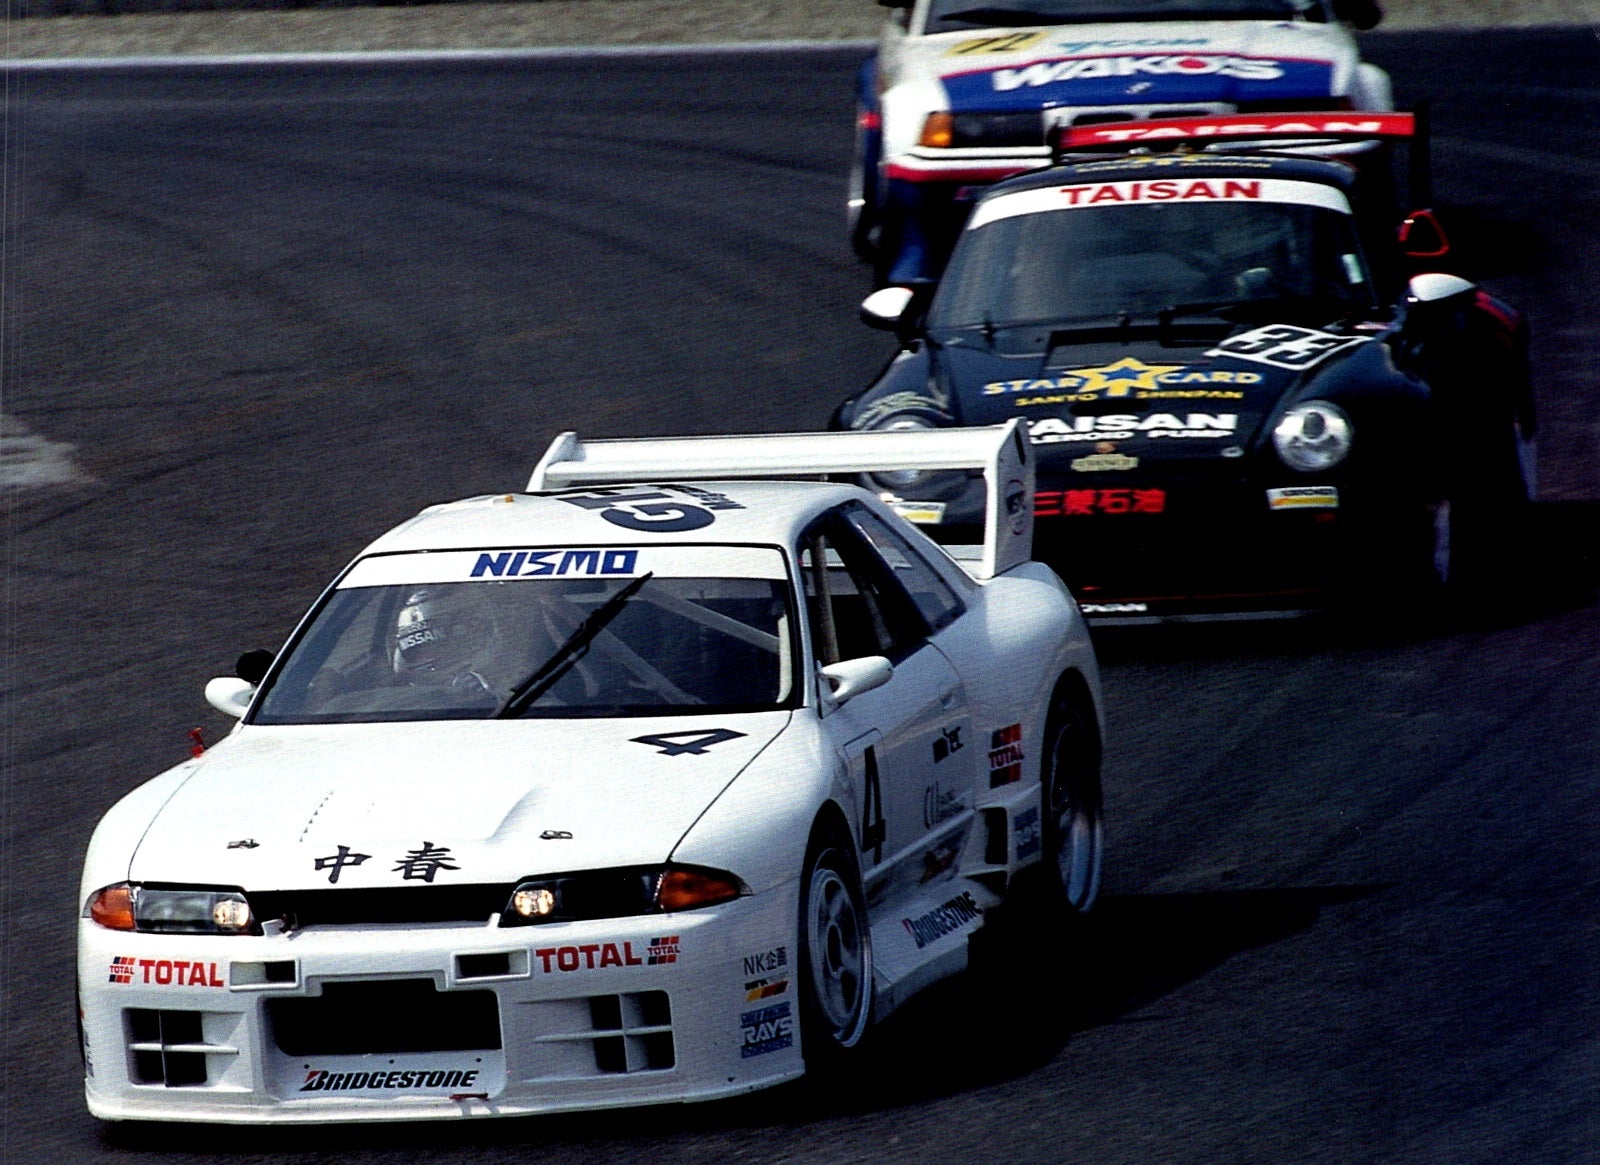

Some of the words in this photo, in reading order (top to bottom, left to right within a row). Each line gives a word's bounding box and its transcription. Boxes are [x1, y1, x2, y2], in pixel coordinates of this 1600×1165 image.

[1099, 121, 1382, 141] TAISAN
[1061, 180, 1261, 206] TAISAN
[982, 375, 1081, 396] STAR
[1158, 369, 1264, 386] CARD
[1027, 413, 1238, 435] AISAN
[469, 550, 640, 578] NISMO
[628, 727, 749, 757] 4
[862, 745, 886, 866] 4
[314, 841, 461, 885] 中春
[534, 941, 642, 973] TOTAL
[647, 945, 681, 957] TOTAL
[138, 958, 225, 988] TOTAL
[741, 1018, 794, 1045] RAYS
[300, 1068, 479, 1092] BRIDGESTONE
